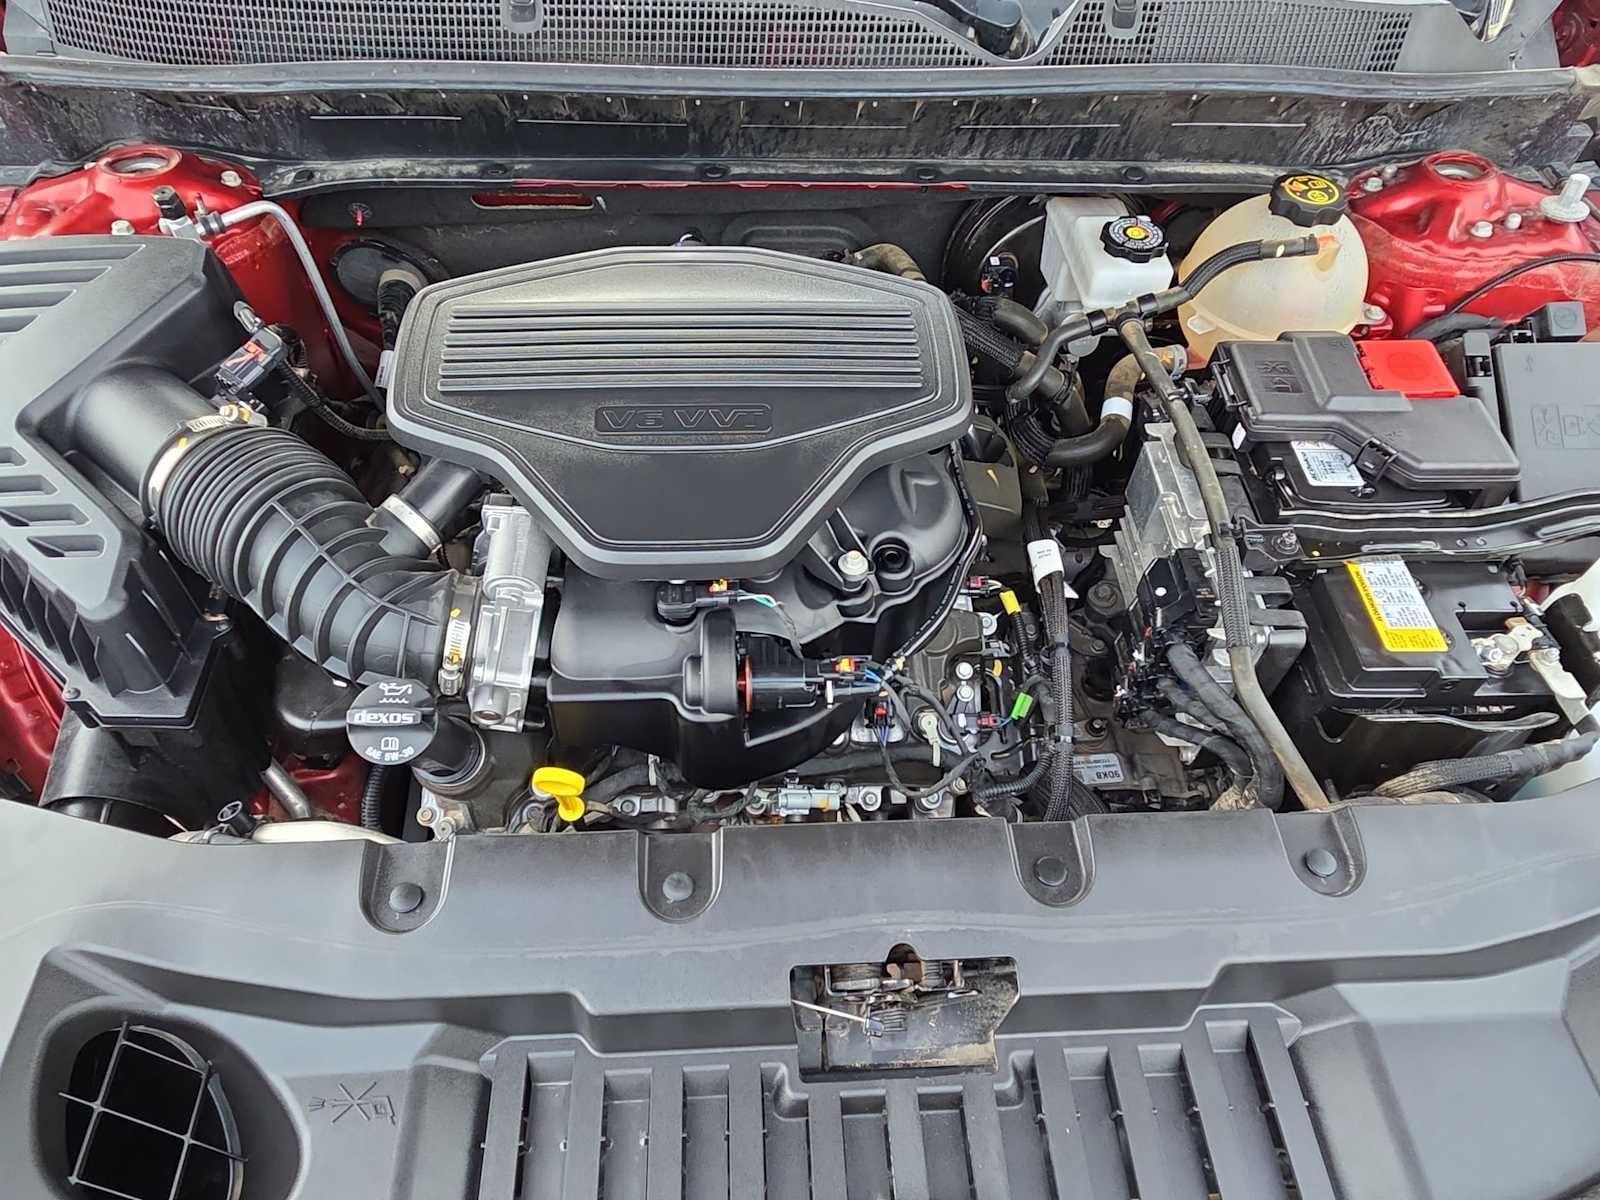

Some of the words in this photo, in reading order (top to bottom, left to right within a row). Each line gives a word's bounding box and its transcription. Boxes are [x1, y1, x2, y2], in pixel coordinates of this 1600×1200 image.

[602, 409, 664, 428] V6
[673, 409, 766, 428] VVT
[353, 710, 417, 724] dexos
[365, 746, 382, 760] SAE
[384, 746, 415, 761] 5W-30
